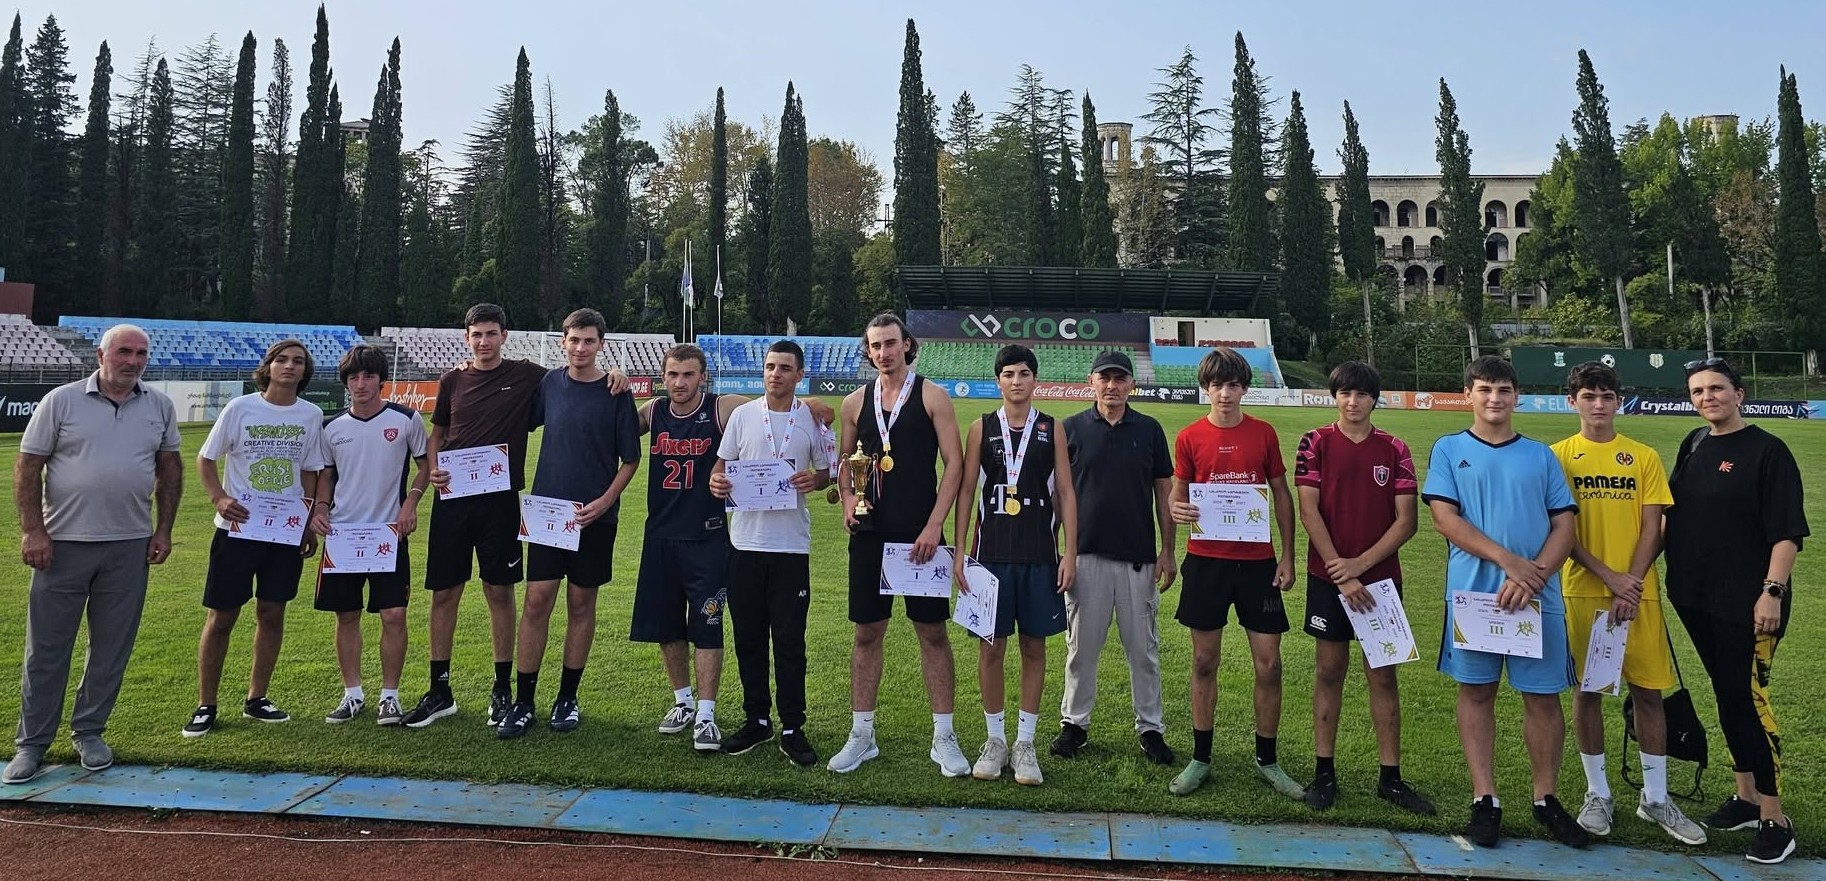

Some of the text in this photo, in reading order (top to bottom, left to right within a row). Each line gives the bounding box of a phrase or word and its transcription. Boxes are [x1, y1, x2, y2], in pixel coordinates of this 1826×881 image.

[1003, 316, 1100, 340] croco
[1548, 397, 1570, 411] ELI
[651, 431, 712, 456] Sixers
[662, 459, 695, 490] 21
[1210, 471, 1249, 481] SpareBank
[1573, 475, 1636, 490] PAMESA
